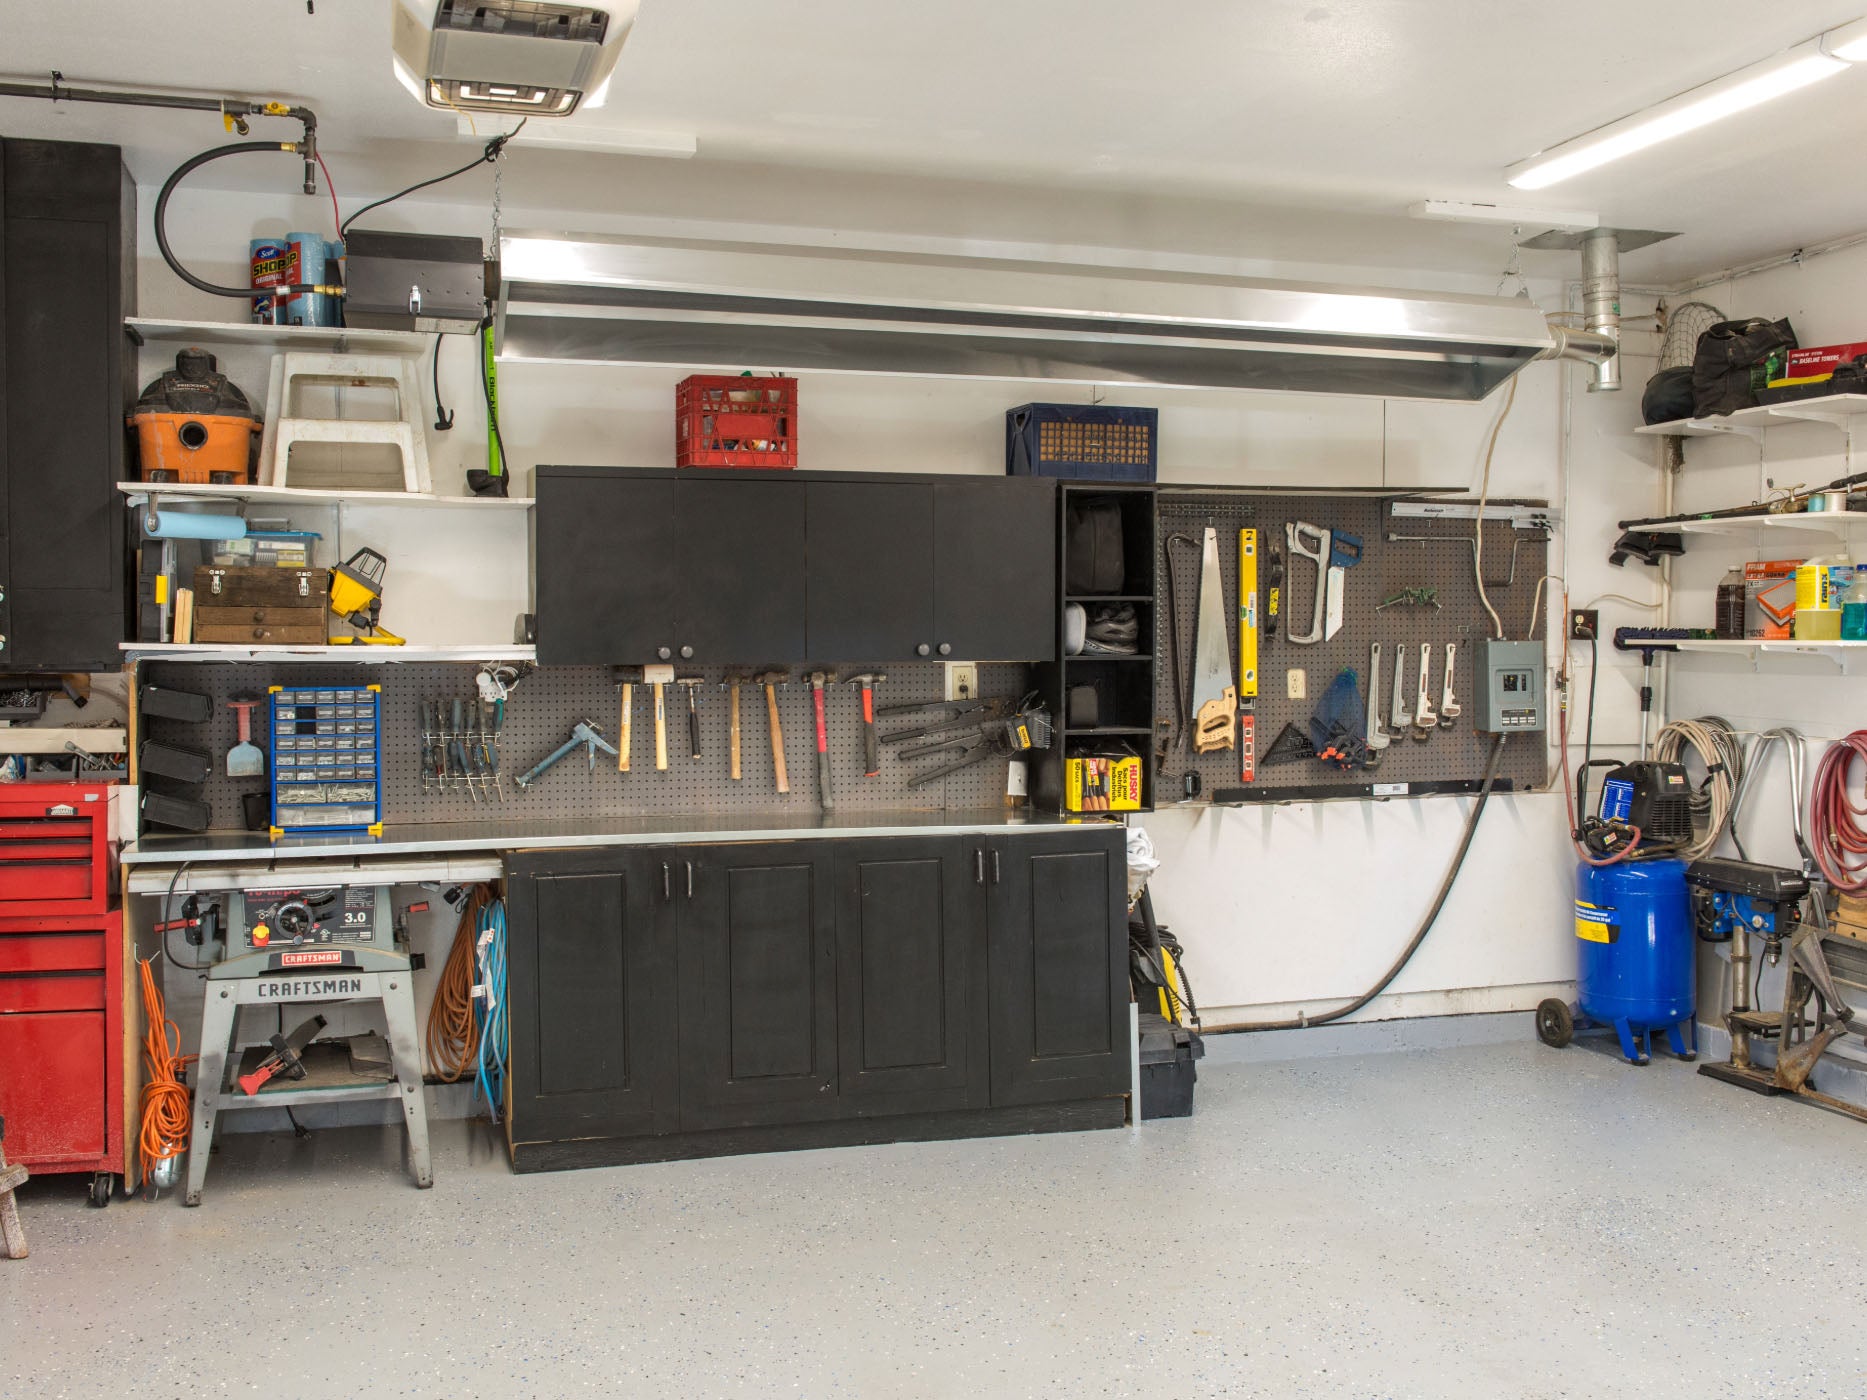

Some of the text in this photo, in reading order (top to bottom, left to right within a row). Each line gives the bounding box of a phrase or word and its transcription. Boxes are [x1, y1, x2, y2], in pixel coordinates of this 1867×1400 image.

[254, 260, 285, 276] SHOP
[256, 273, 282, 284] ORIGINAL
[1129, 765, 1138, 802] HUSKY
[344, 912, 366, 923] 3.0
[284, 953, 340, 963] CRAFTSMAN
[258, 978, 361, 997] CRAFTSMAN
